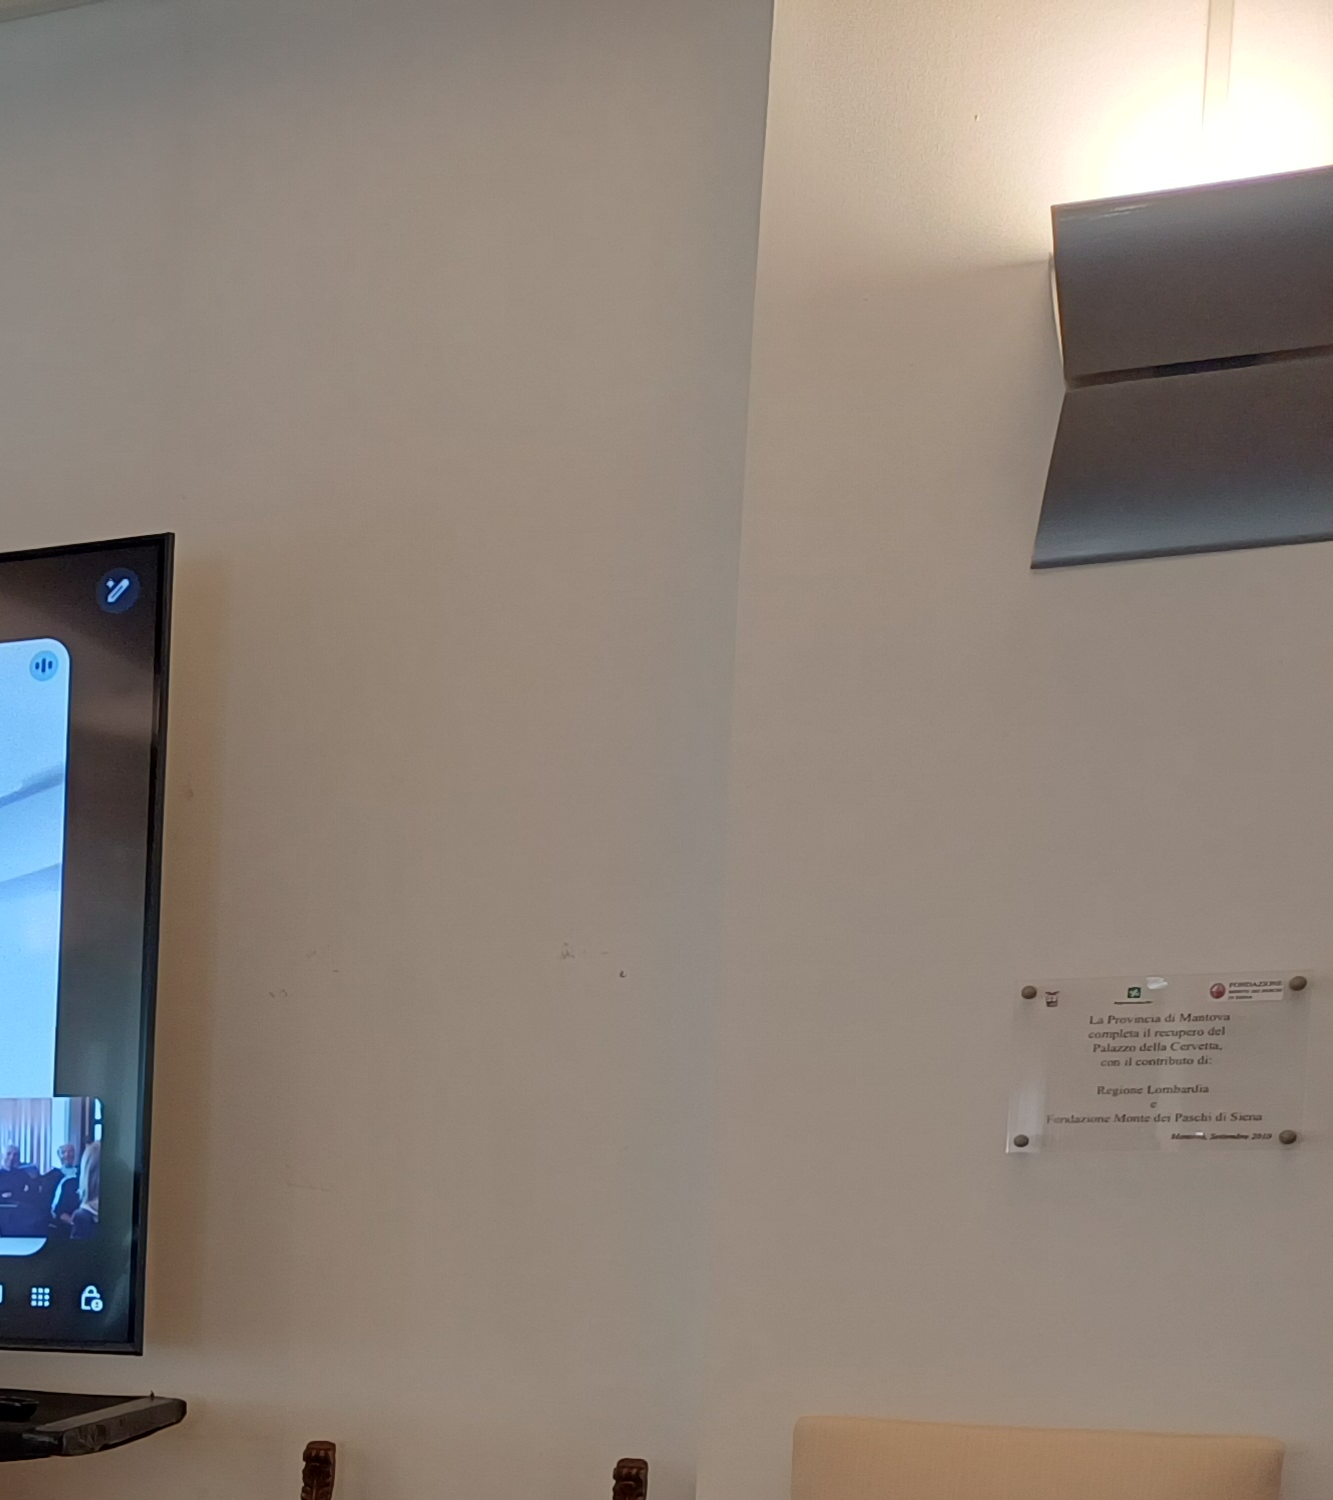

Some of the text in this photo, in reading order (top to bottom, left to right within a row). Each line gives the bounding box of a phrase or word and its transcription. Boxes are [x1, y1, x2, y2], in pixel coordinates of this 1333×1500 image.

[1089, 1013, 1231, 1025] La Provincia di Mantova
[1143, 1028, 1151, 1038] il
[1154, 1028, 1205, 1039] recupero
[1207, 1026, 1226, 1036] del
[1093, 1043, 1136, 1053] Palazzo
[1139, 1042, 1167, 1052] della
[1100, 1058, 1121, 1067] con
[1124, 1057, 1133, 1066] il
[1135, 1056, 1194, 1067] contributo
[1097, 1084, 1210, 1096] Regione Lombardia
[1046, 1112, 1263, 1124] Fondazione Monte dei Paschi di Siena
